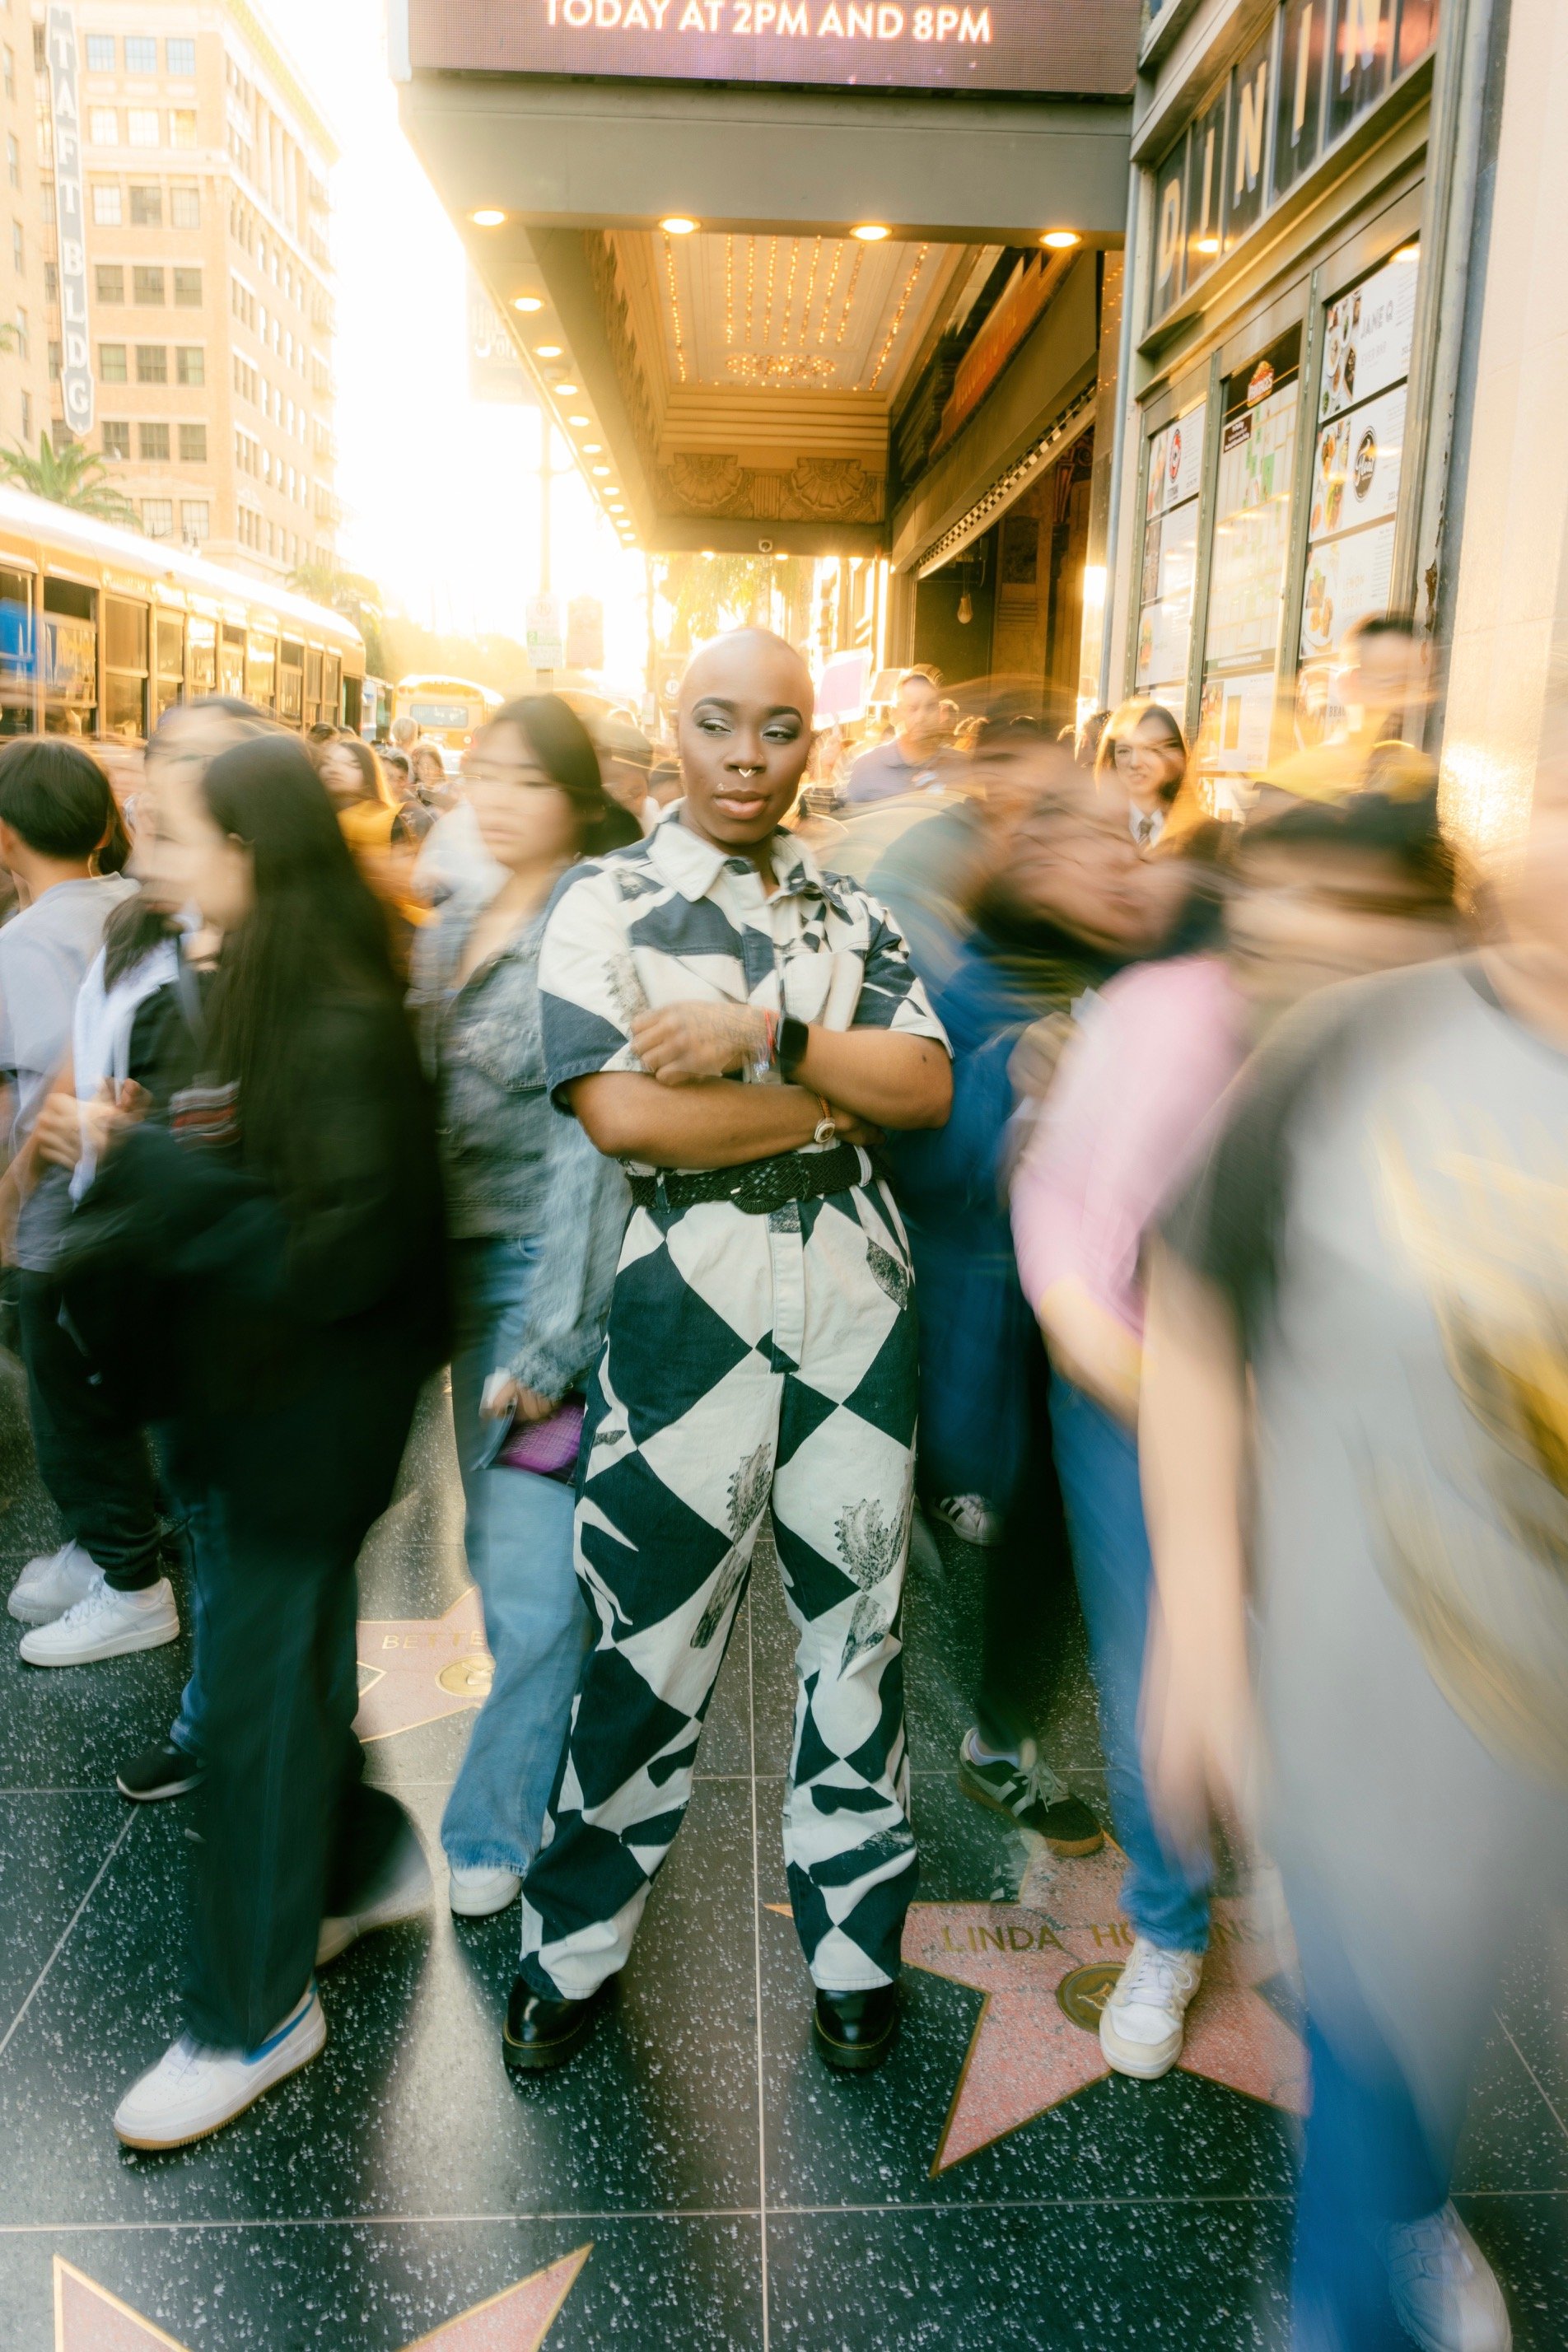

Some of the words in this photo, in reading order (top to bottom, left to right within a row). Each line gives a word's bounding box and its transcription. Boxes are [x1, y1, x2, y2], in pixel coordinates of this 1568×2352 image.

[547, 0, 669, 30] TODAY
[678, 0, 725, 33] AT
[732, 0, 809, 36] 2PM
[817, 0, 904, 39] AND
[912, 5, 991, 43] 8PM
[51, 27, 81, 214] TAFT
[62, 236, 90, 414] BLDG
[381, 1630, 486, 1650] BETTE
[943, 1924, 1066, 1953] LINDA
